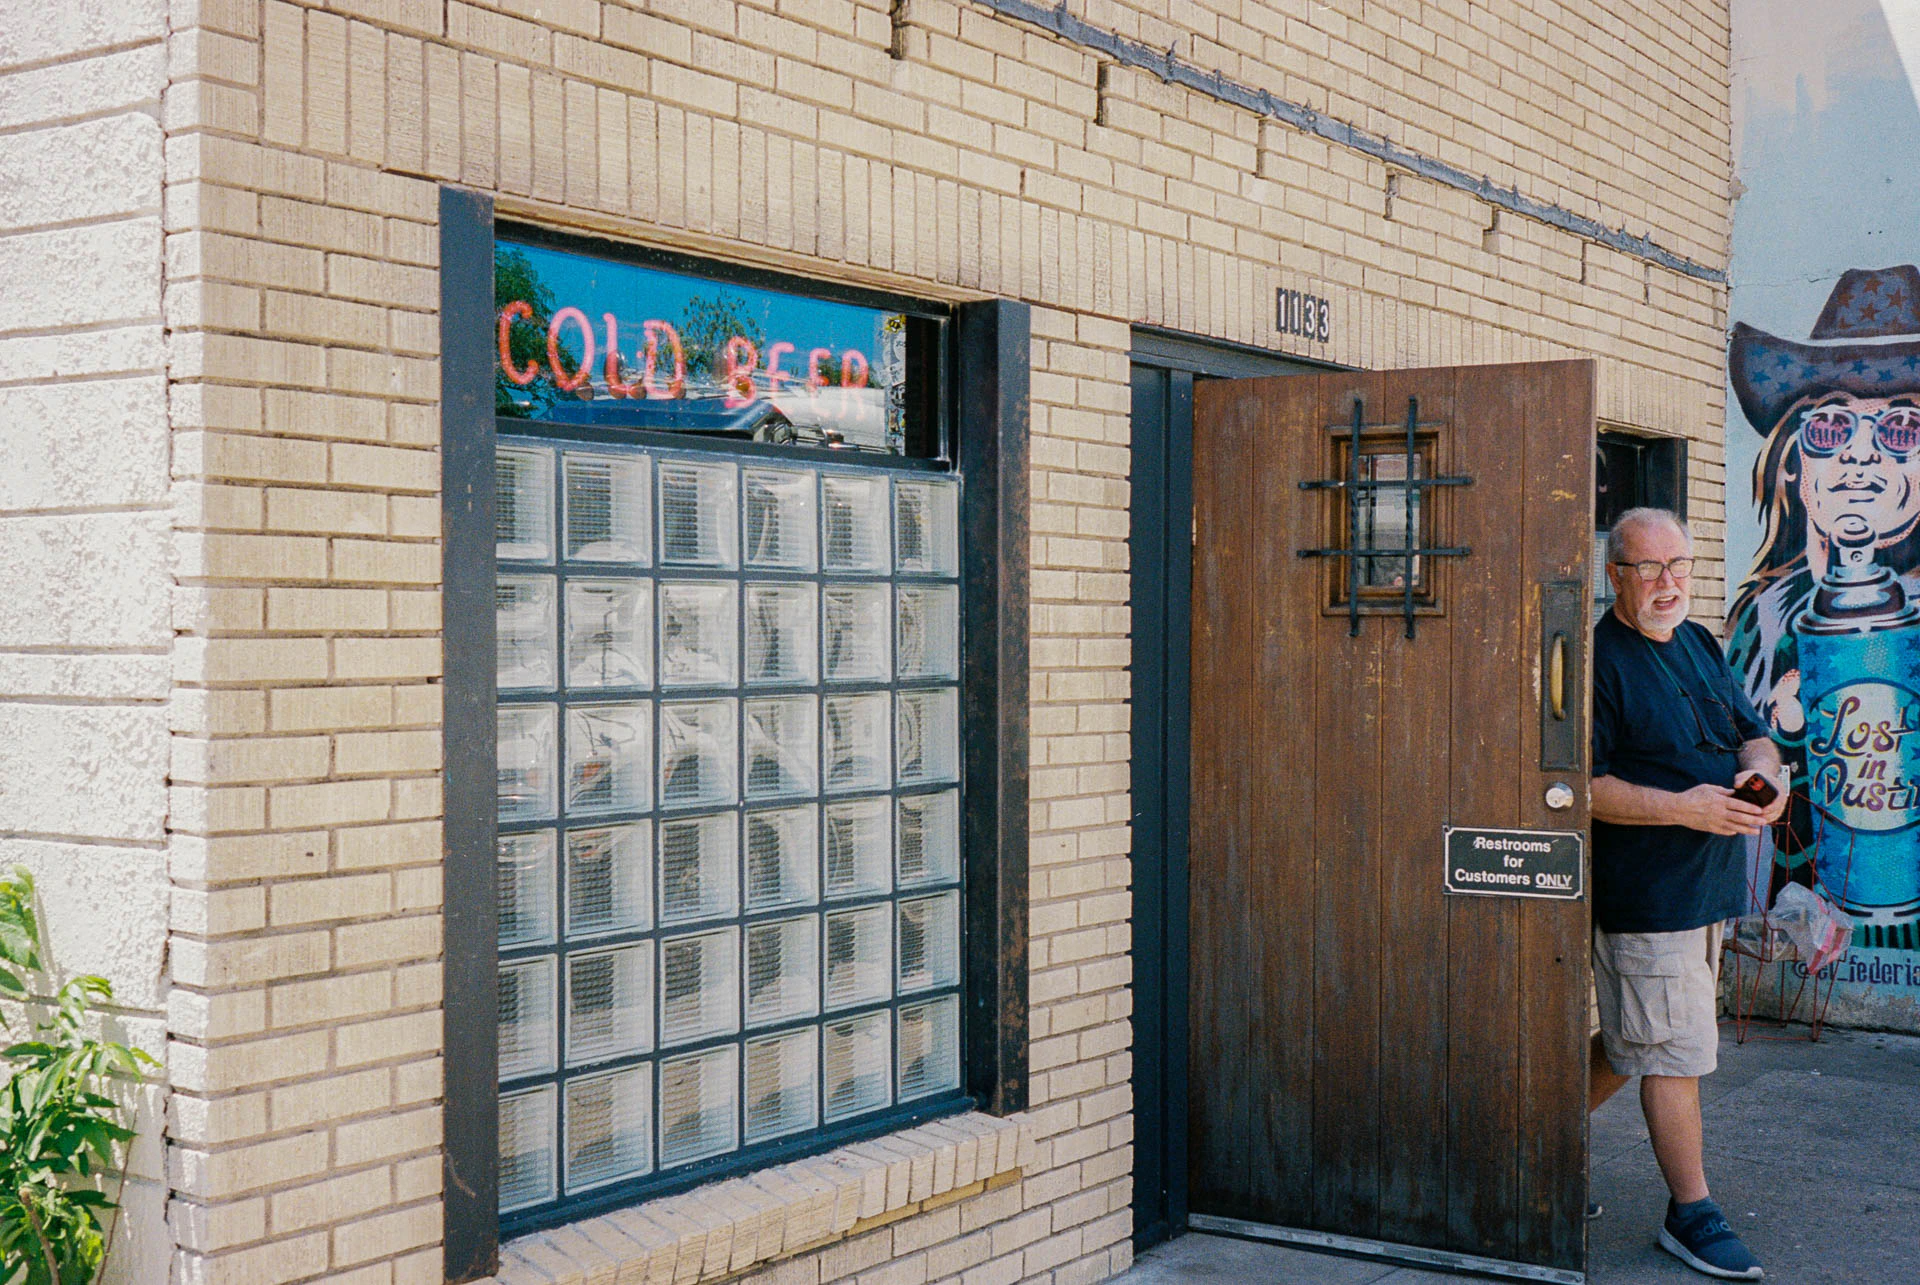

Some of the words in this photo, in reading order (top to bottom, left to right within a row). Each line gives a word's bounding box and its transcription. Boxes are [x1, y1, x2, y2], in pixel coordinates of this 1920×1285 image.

[1278, 293, 1330, 339] 1133
[499, 300, 688, 400] COLD
[724, 335, 871, 419] BEER
[1809, 696, 1916, 757] Lost
[1857, 753, 1887, 780] in
[1475, 836, 1552, 853] Restrooms
[1503, 854, 1525, 868] for
[1454, 868, 1531, 886] Customers
[1535, 872, 1573, 888] ONLY
